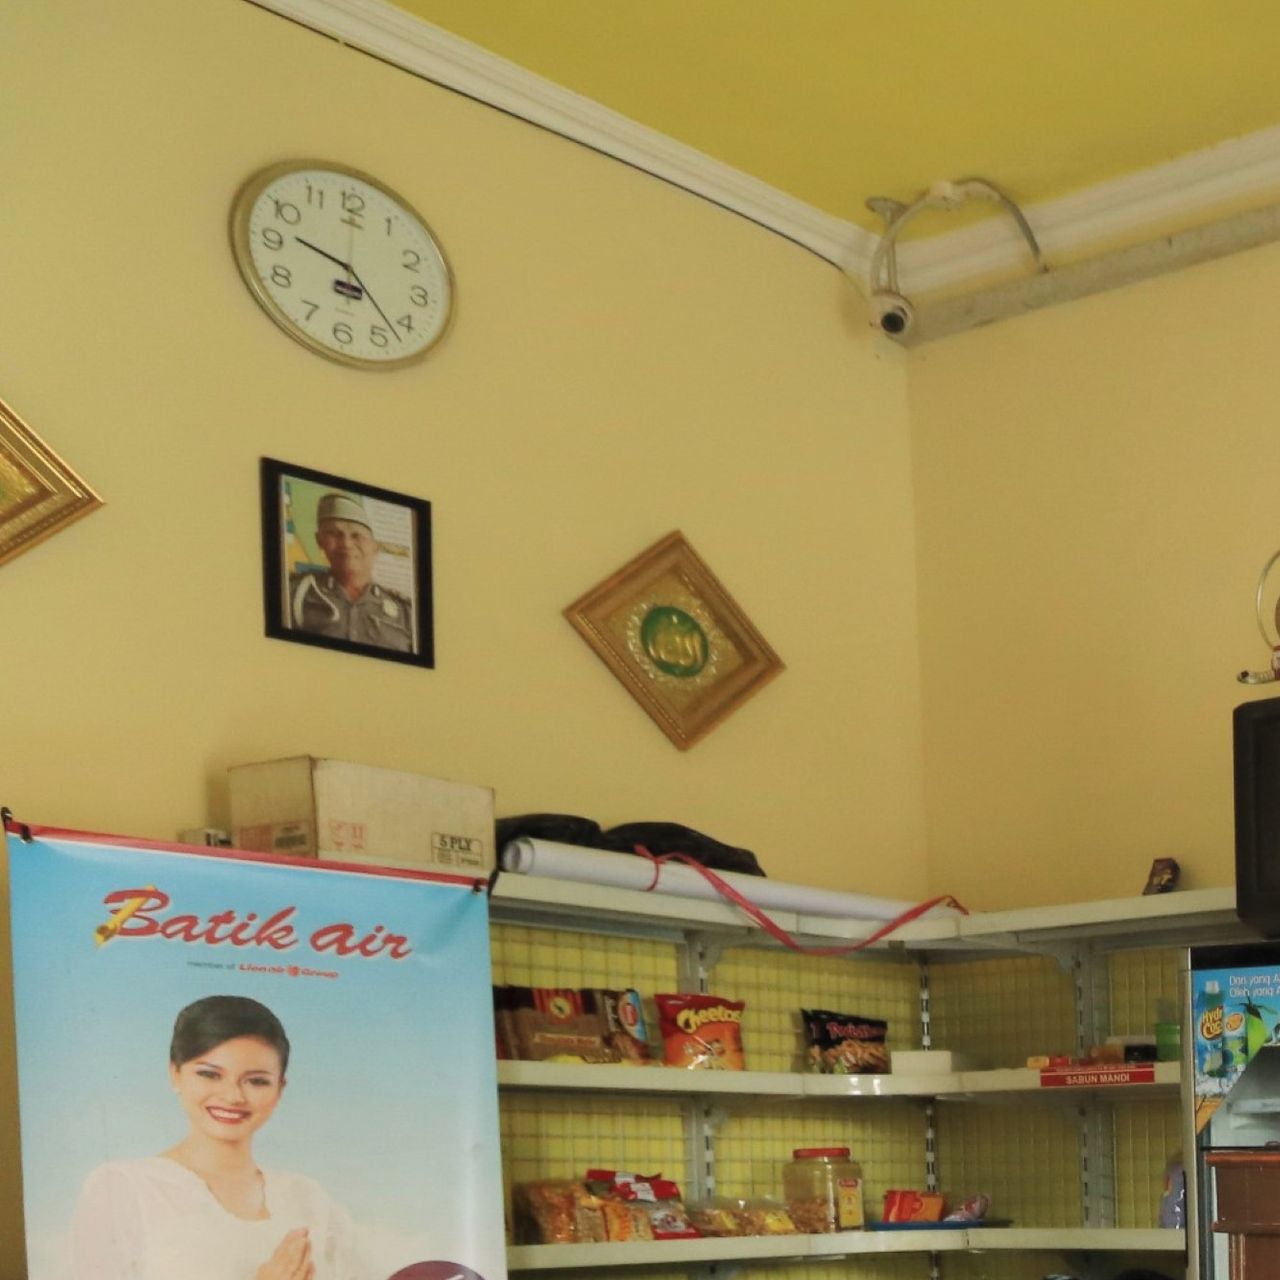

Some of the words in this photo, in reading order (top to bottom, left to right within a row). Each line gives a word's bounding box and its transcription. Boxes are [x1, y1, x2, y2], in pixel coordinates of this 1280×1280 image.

[305, 184, 324, 209] 11
[340, 190, 366, 217] 12
[274, 199, 301, 226] 10
[384, 216, 393, 237] 1
[262, 228, 284, 251] 9
[402, 249, 421, 273] 2
[271, 264, 292, 289] 8
[410, 285, 429, 308] 3
[301, 300, 320, 322] 7
[332, 322, 353, 345] 6
[396, 314, 415, 333] 4
[369, 325, 389, 348] 5
[450, 835, 472, 852] PLY
[97, 884, 299, 951] Batik
[310, 923, 413, 960] air
[676, 1004, 744, 1035] Cheetos
[1065, 1075, 1098, 1086] SABUN
[1099, 1073, 1130, 1084] MANDI
